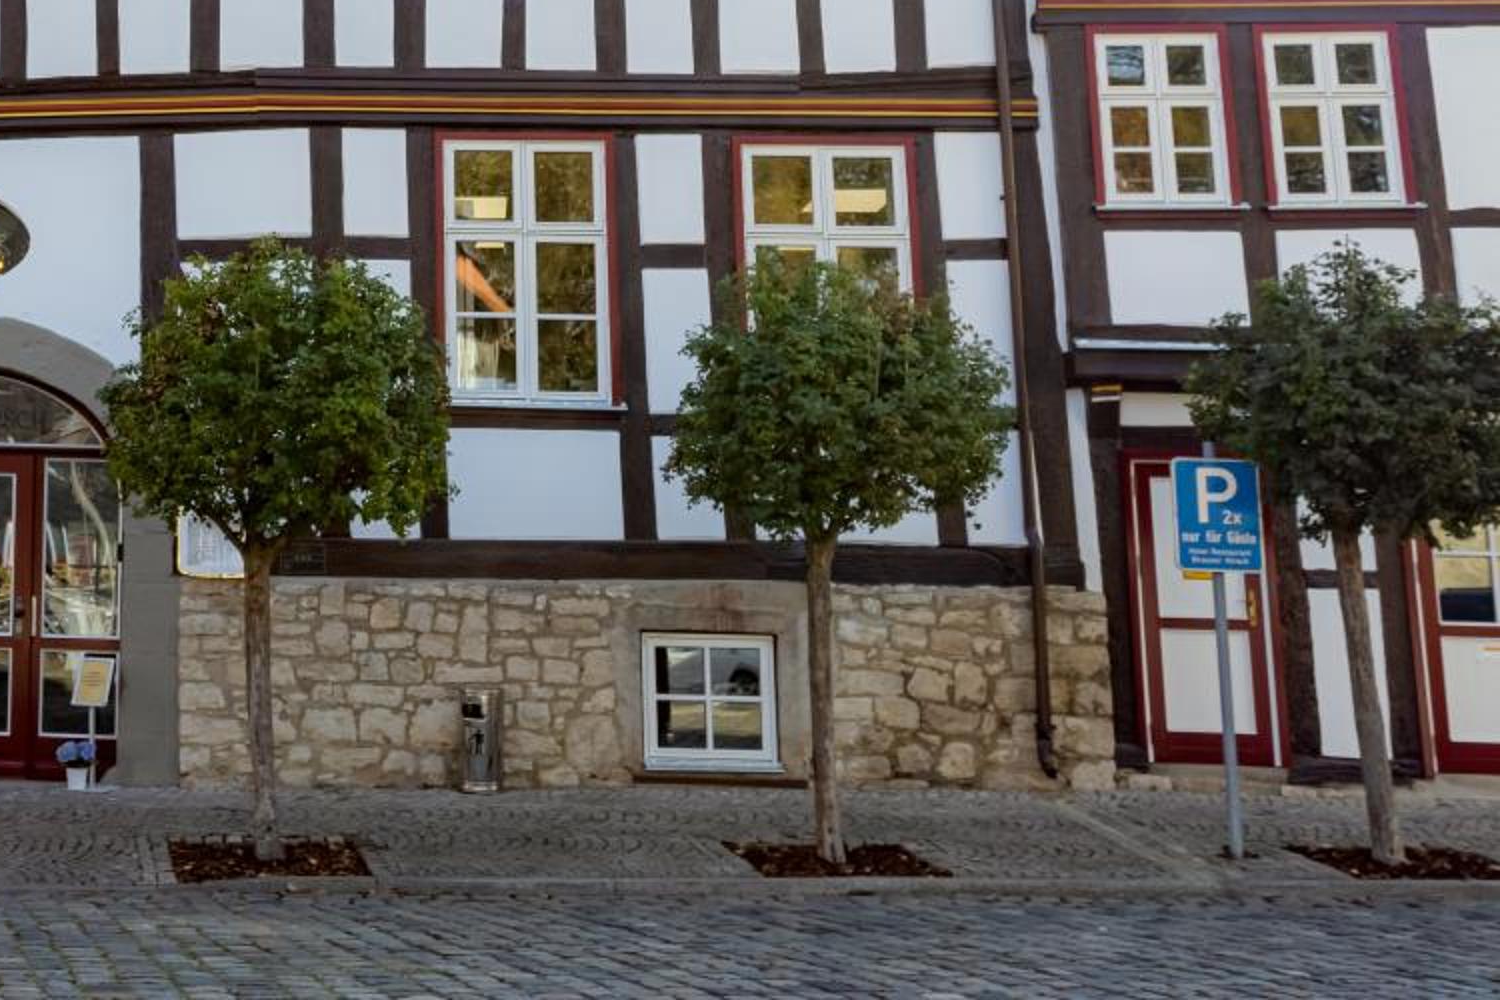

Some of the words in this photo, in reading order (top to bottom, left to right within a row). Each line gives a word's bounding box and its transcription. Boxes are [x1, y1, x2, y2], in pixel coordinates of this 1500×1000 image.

[1195, 467, 1238, 524] P
[1222, 509, 1243, 525] 2x
[1204, 529, 1223, 543] für
